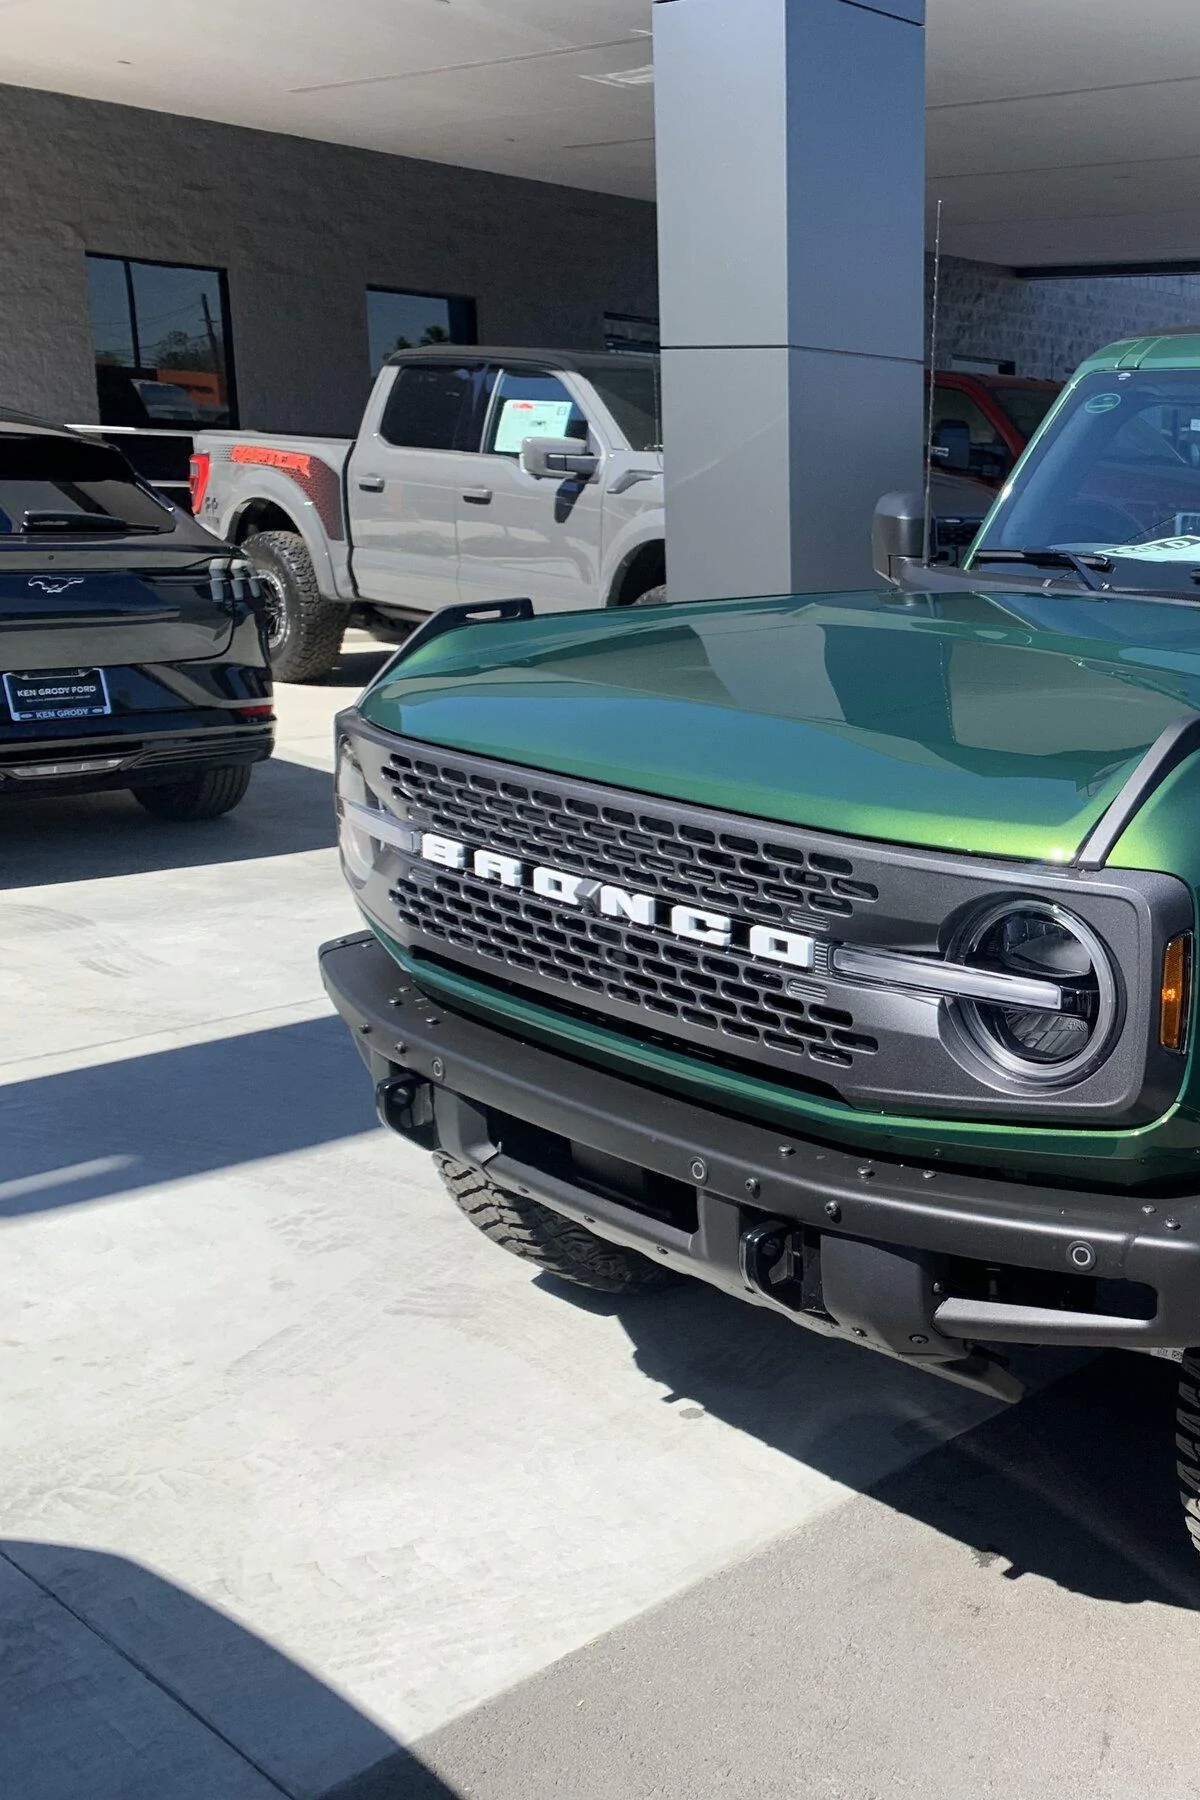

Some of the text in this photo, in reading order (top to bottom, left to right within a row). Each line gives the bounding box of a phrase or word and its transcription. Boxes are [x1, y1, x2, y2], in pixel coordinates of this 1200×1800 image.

[17, 685, 97, 697] KEN GRODY FORD
[36, 709, 89, 719] KEN GRODY
[422, 832, 814, 968] BRONCO
